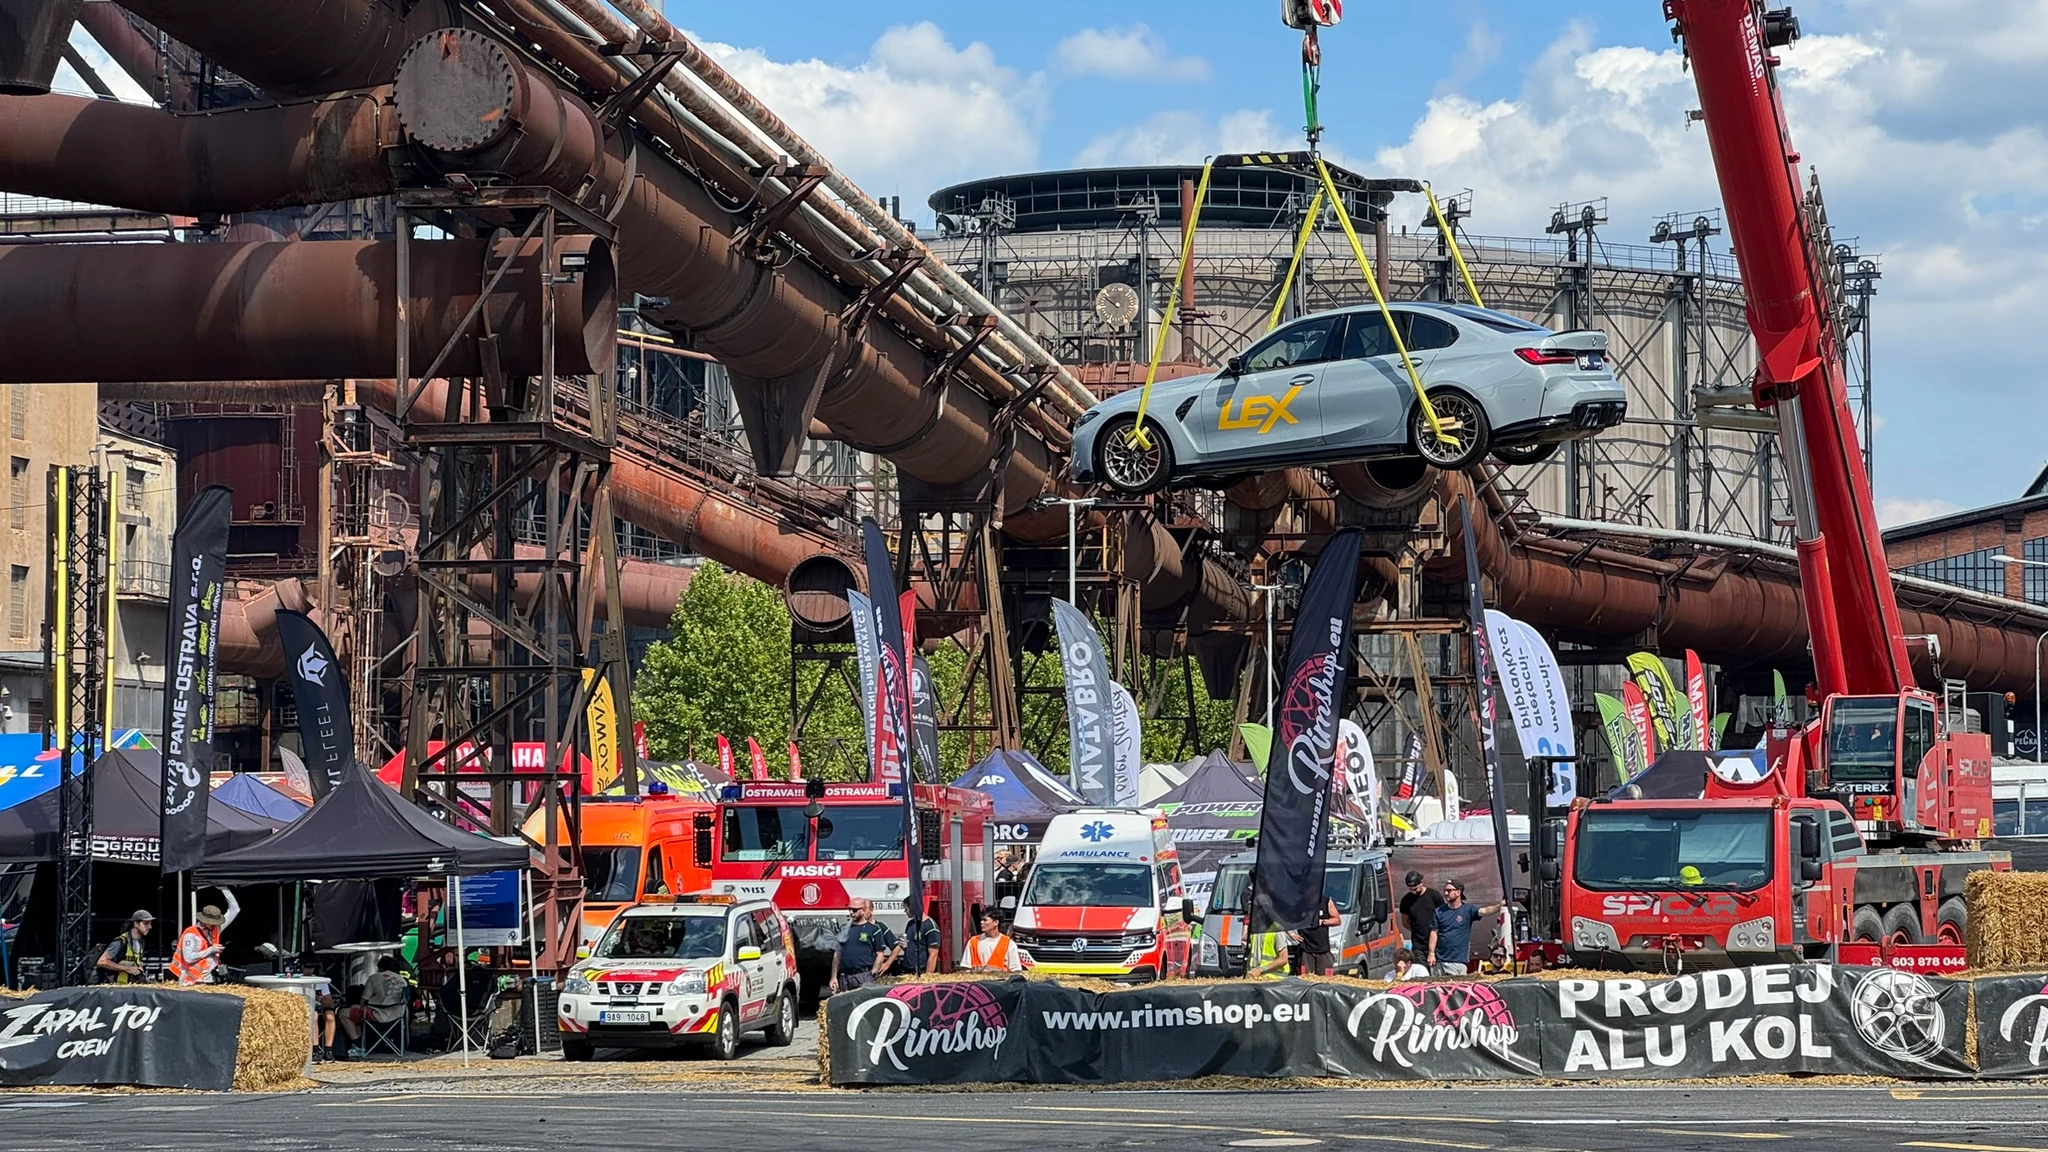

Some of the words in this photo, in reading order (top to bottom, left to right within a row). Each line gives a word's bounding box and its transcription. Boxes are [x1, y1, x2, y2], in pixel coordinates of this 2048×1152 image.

[1743, 13, 1765, 79] DEMAG
[1218, 384, 1306, 434] LEX
[170, 603, 198, 754] PAME-OSTRAVA
[976, 775, 1006, 787] AP
[1849, 784, 1889, 792] TEREX
[745, 788, 805, 798] OSTRAVA!!!
[825, 788, 885, 797] OSTRAVA!!!
[1169, 801, 1263, 817] POWER
[1060, 850, 1130, 859] AMBULANCE
[781, 863, 842, 877] HASIČI
[1602, 895, 1739, 916] SPICAR
[1892, 957, 1915, 967] 603
[1918, 956, 1940, 967] 878
[1942, 956, 1965, 967] 044
[1559, 963, 1838, 1018] PRODEJ
[111, 1002, 162, 1032] TO!
[607, 1013, 621, 1022] 9A9
[627, 1013, 645, 1022] 1048
[1042, 1000, 1310, 1031] www.rimshop.eu
[846, 997, 1007, 1071] Rimshop
[1347, 993, 1519, 1068] Rimshop
[57, 1036, 116, 1059] CREW
[1564, 1024, 1687, 1073] ALU
[1710, 1014, 1832, 1063] KOL
